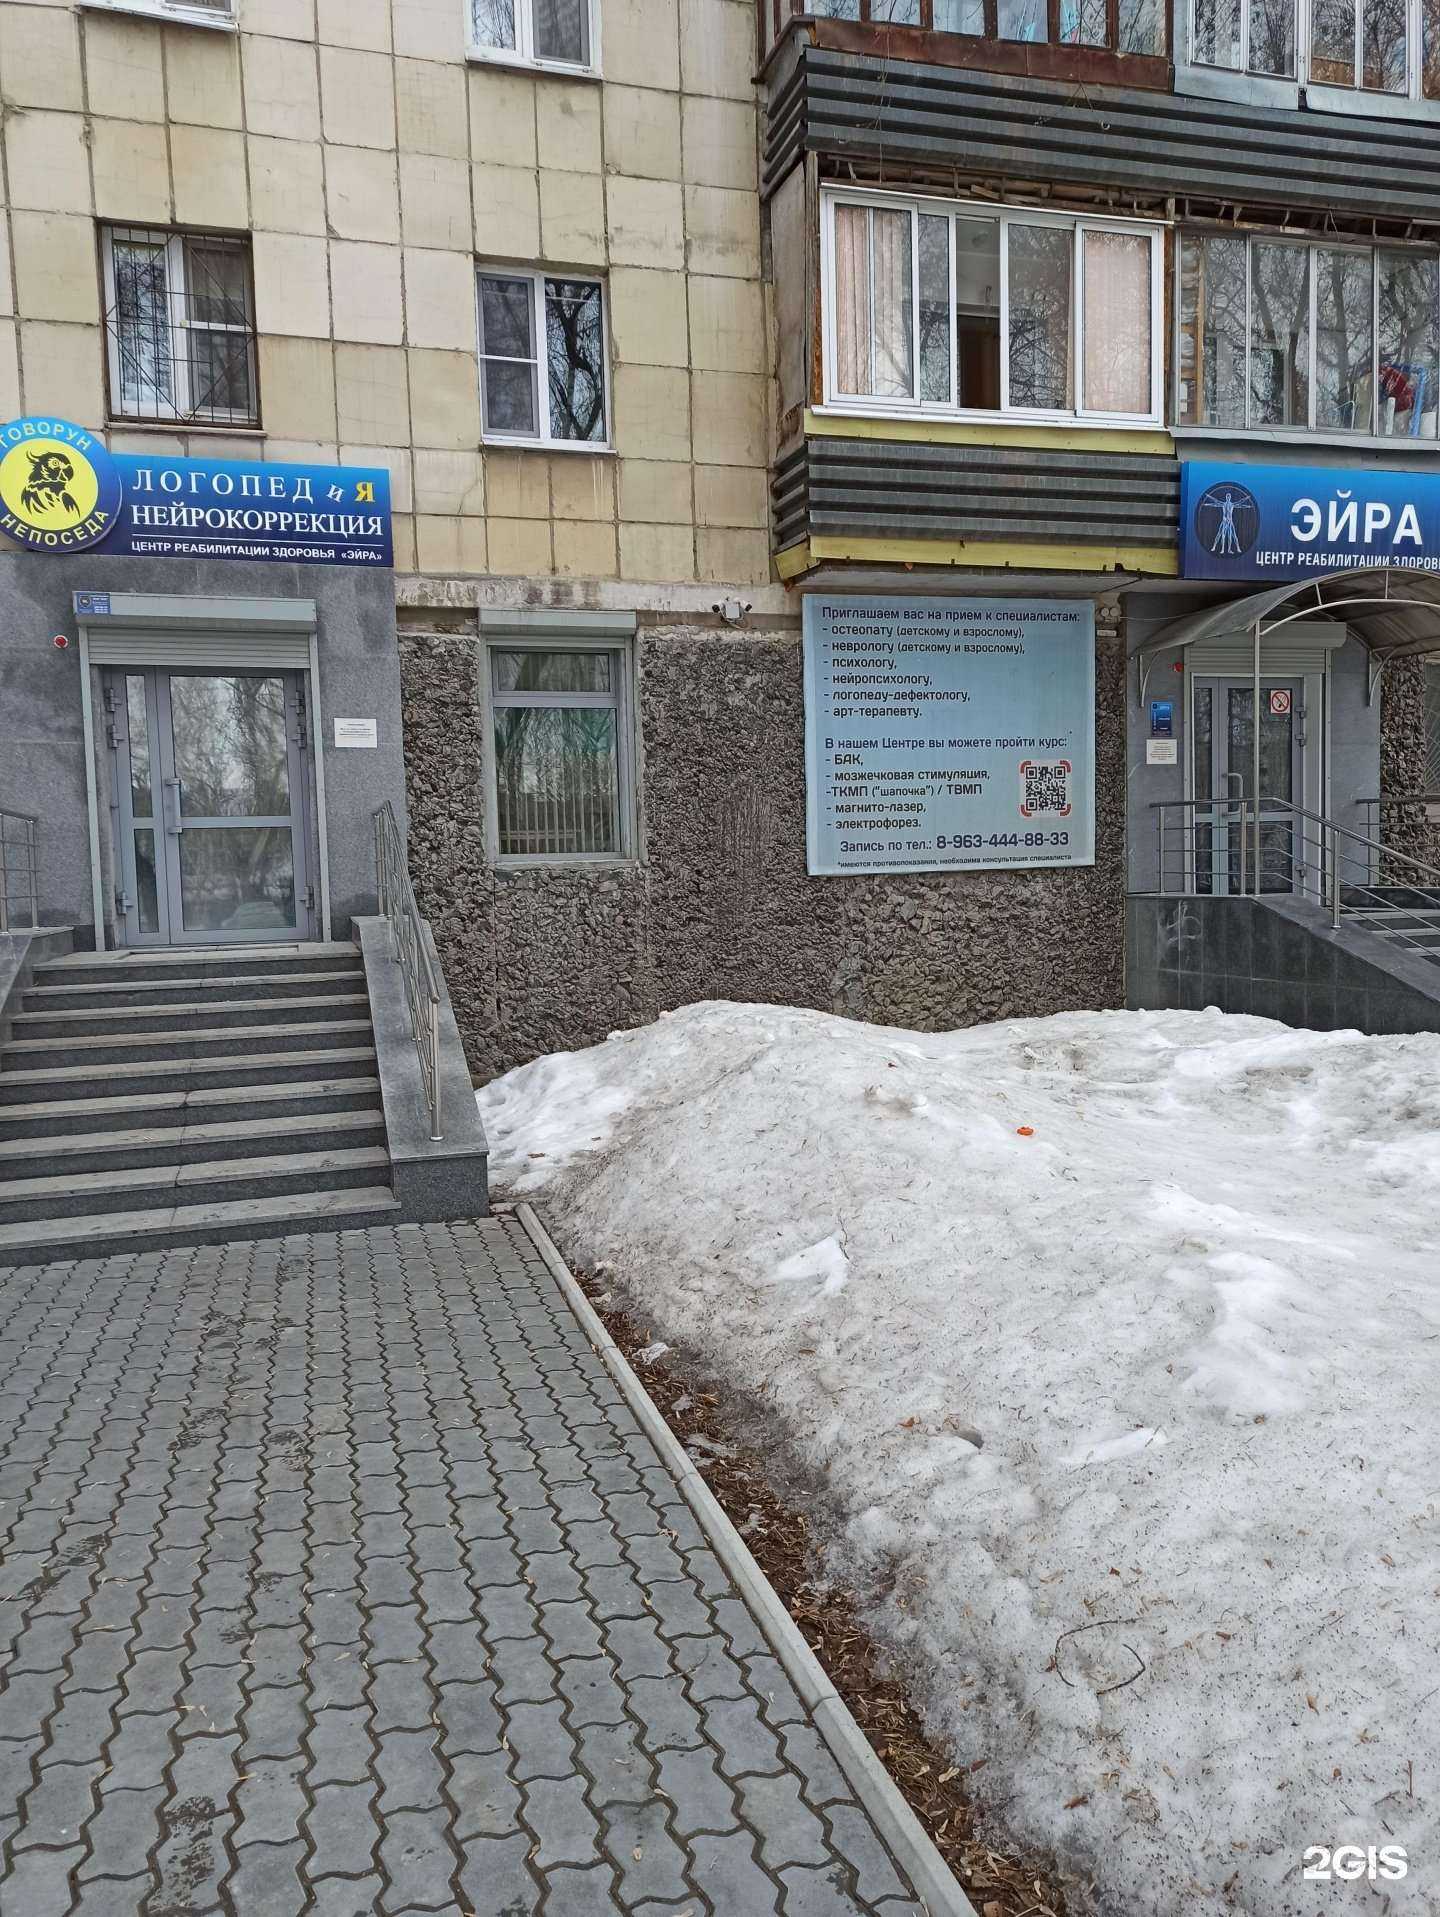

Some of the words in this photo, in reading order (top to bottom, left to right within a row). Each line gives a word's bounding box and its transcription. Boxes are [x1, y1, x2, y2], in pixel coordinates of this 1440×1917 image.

[132, 469, 314, 503] ЛОГОПЕД
[327, 484, 344, 502] и
[355, 482, 375, 502] Я
[131, 501, 383, 538] НЕЙРОКОРРЕКЦИЯ
[1291, 489, 1423, 545] ЭЙРА
[0, 511, 109, 545] НЕПОСЕДА
[131, 541, 171, 552] ЦЕНТР
[174, 543, 270, 557] РЕАБИЛИТАЦИИ
[272, 547, 335, 559] ЗДОРОВЬЯ
[341, 550, 382, 561] «ЭЙРА»
[1256, 551, 1294, 566] ЦЕНТР
[1298, 552, 1389, 567] РЕАБИЛИТАЦИИ
[822, 606, 900, 620] Приглашаем
[903, 610, 924, 619] вас
[928, 611, 942, 619] на
[945, 611, 982, 622] прием
[995, 612, 1080, 621] специалистам:
[831, 625, 893, 637] остеопату
[897, 626, 950, 638] (детскому
[963, 627, 1024, 638] взрослому),
[832, 642, 894, 654] неврологу
[897, 643, 951, 654] (детскому
[954, 645, 961, 653] и
[964, 643, 1025, 654] взрослому),
[832, 658, 897, 670] психологу,
[832, 672, 932, 686] нейропсихологу,
[832, 690, 970, 702] логопеду-дефектологу,
[833, 707, 922, 718] арт-терапевту.
[825, 738, 834, 749] В
[838, 740, 878, 749] нашем
[882, 738, 925, 750] Центре
[929, 740, 944, 748] вы
[948, 739, 992, 748] можете
[995, 737, 1035, 749] пройти
[1039, 738, 1067, 748] курс:
[834, 754, 864, 766] БАК,
[835, 771, 914, 781] мозжечковая
[918, 770, 990, 781] стимуляция,
[946, 784, 982, 795] ТВМП
[835, 803, 926, 813] магнито-лазер,
[835, 818, 922, 830] электрофорез.
[840, 841, 884, 852] Запись
[888, 842, 902, 850] по
[906, 840, 932, 850] тел.:
[936, 832, 1069, 849] 8-963-444-88-33
